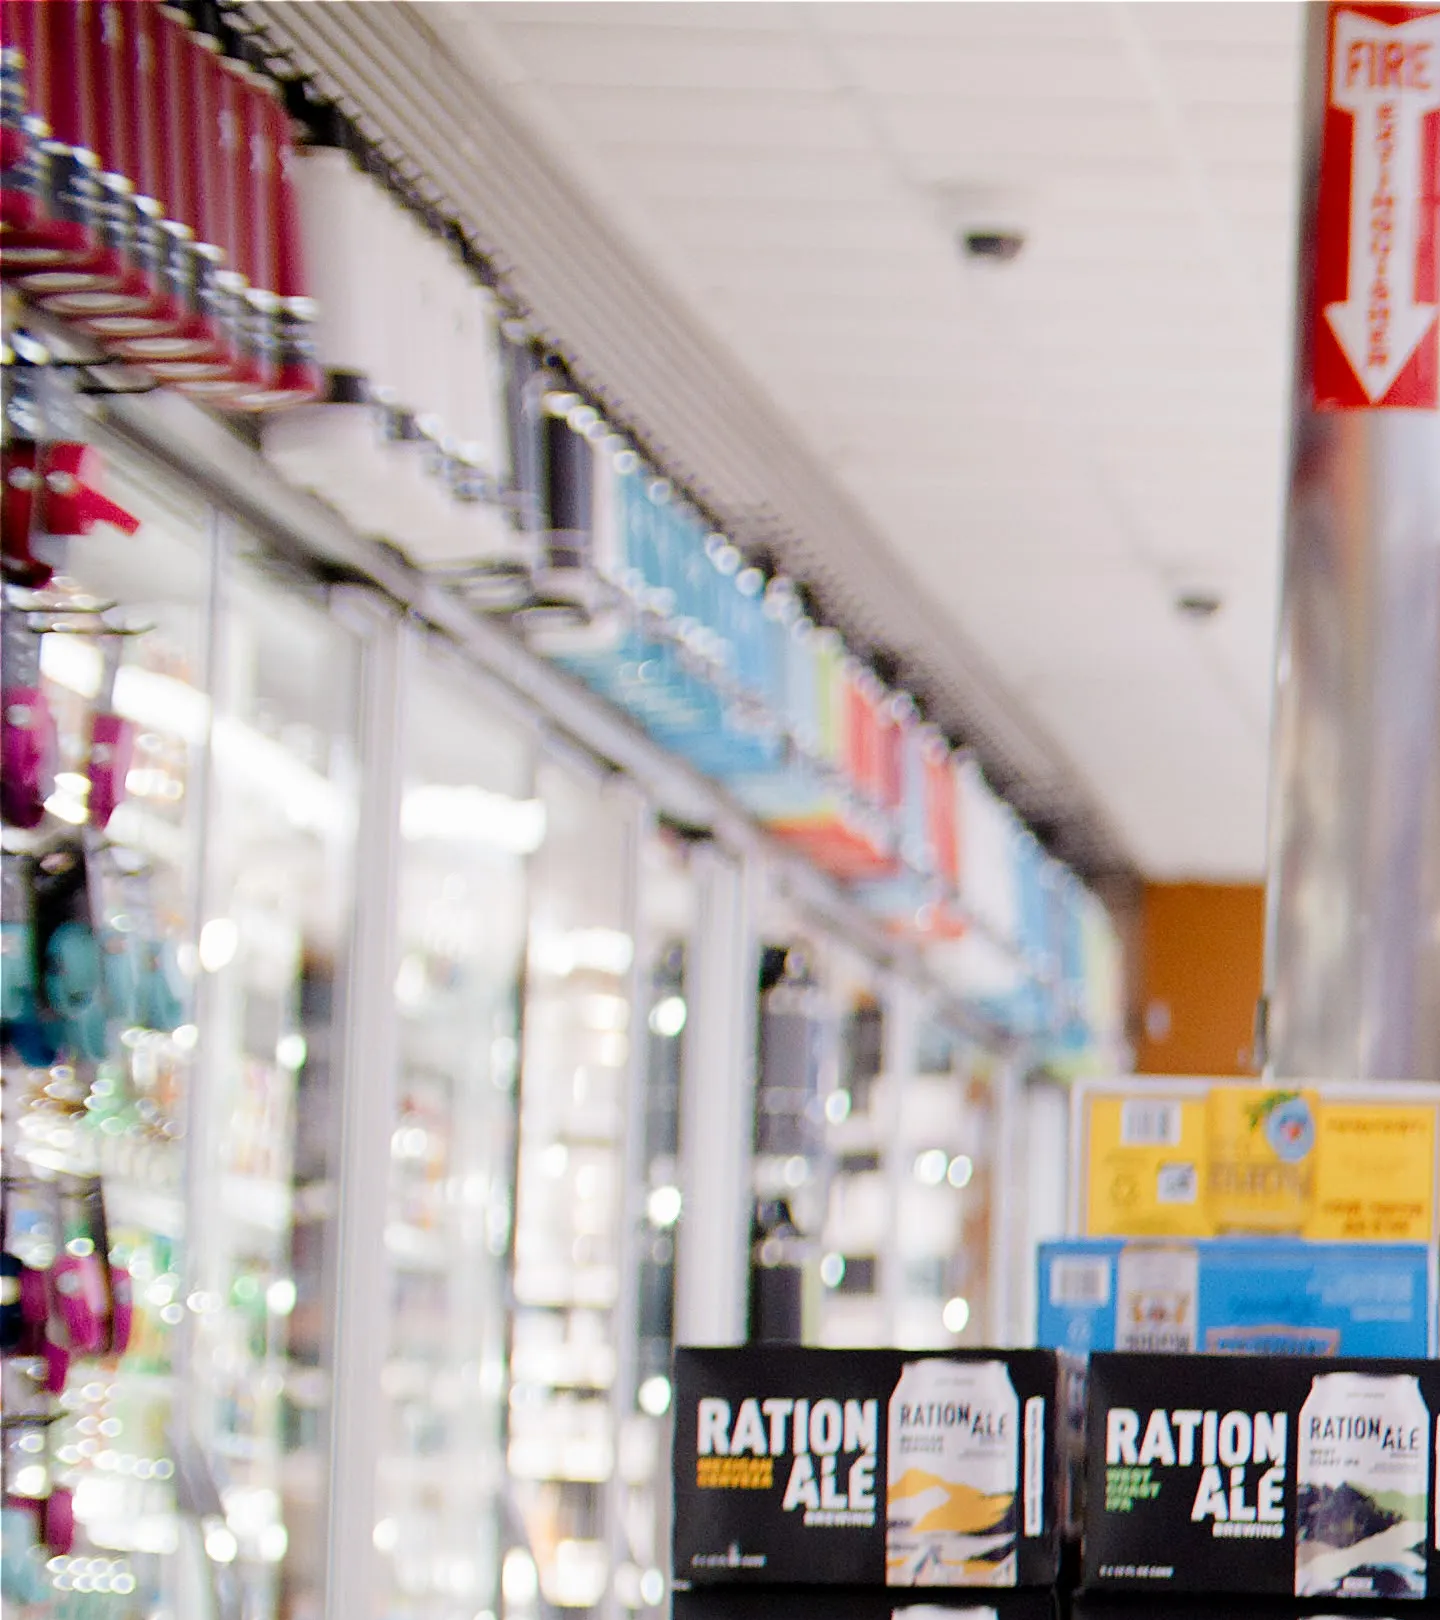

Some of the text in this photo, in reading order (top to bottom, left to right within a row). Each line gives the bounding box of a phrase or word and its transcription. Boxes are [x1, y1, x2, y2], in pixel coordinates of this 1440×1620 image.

[1346, 40, 1432, 90] FIRE
[697, 1397, 878, 1456] RATION
[1105, 1407, 1288, 1466] RATION
[1309, 1413, 1382, 1441] RATION
[1380, 1426, 1420, 1451] ALE
[782, 1453, 877, 1512] ALE
[1190, 1465, 1286, 1522] ALE
[1211, 1520, 1286, 1539] BREWING
